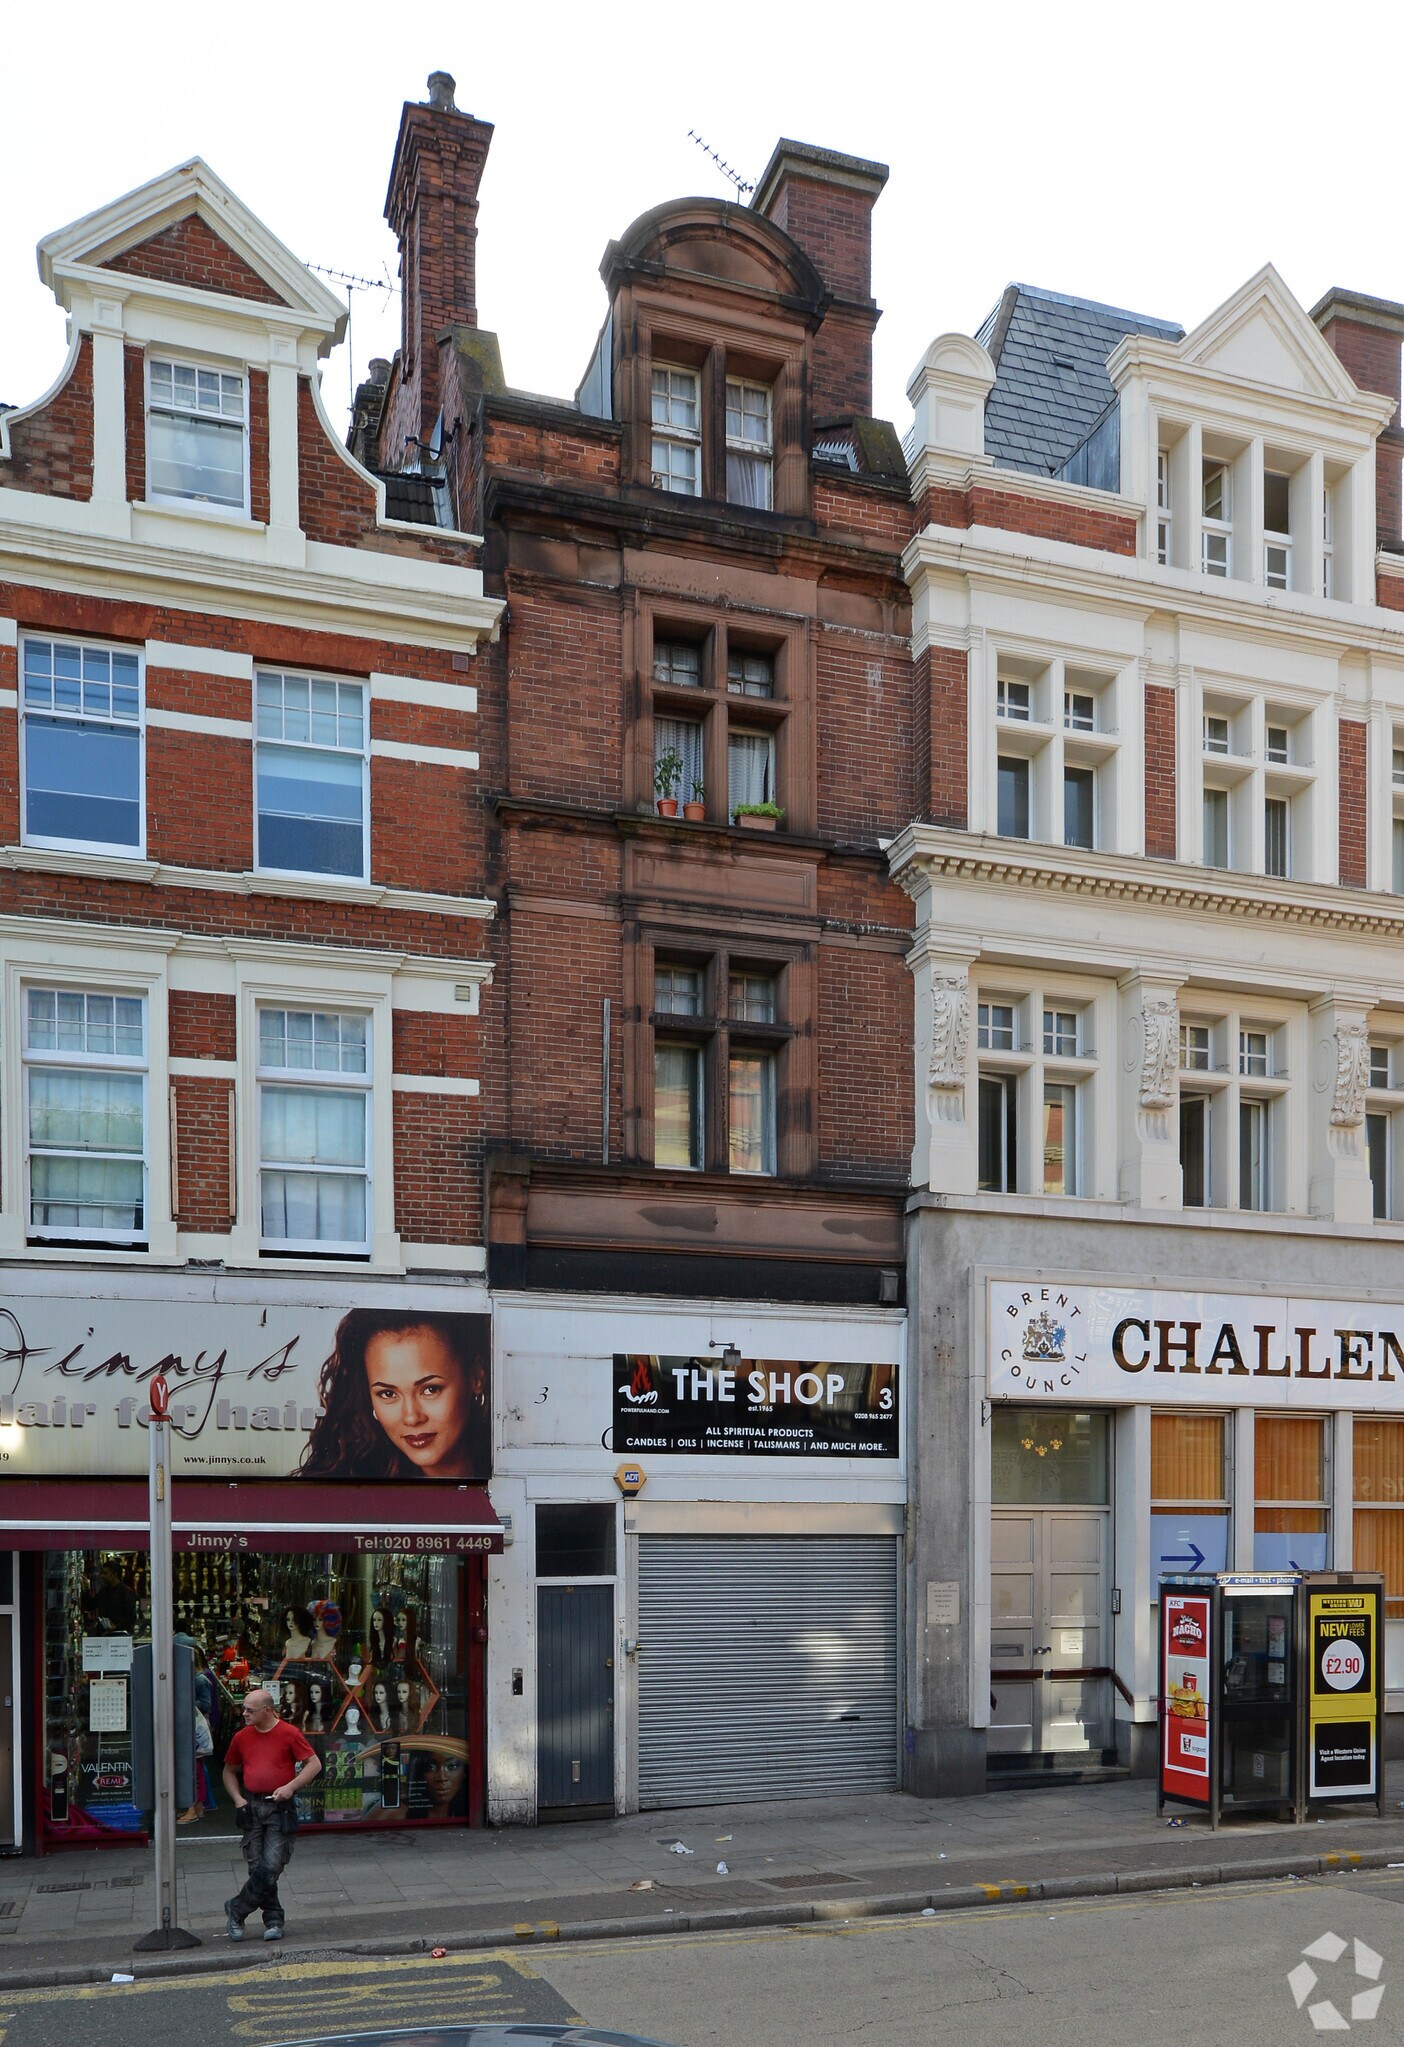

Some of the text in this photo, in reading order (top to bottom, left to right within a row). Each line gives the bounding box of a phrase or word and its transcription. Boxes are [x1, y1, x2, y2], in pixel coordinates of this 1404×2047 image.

[1006, 1289, 1081, 1318] BRENT
[1001, 1349, 1087, 1392] COUNCIL
[672, 1368, 845, 1405] THE SHOP
[534, 1386, 549, 1405] 3
[879, 1387, 892, 1410] 3
[217, 1399, 326, 1429] hair
[706, 1426, 814, 1438] ALL SPIRITUAL PRODUCTS
[626, 1437, 888, 1451] CANDLES OILS INCENSE TALISMANS AND MUCH MORE..
[183, 1455, 267, 1466] www.jinnys.co.uk
[625, 1473, 638, 1482] ADT
[354, 1535, 492, 1550] Tel:020 8961 4449
[1276, 1577, 1295, 1585] phone
[1320, 1623, 1348, 1637] NEW
[1349, 1628, 1365, 1637] FEES
[1326, 1657, 1360, 1675] £2.90
